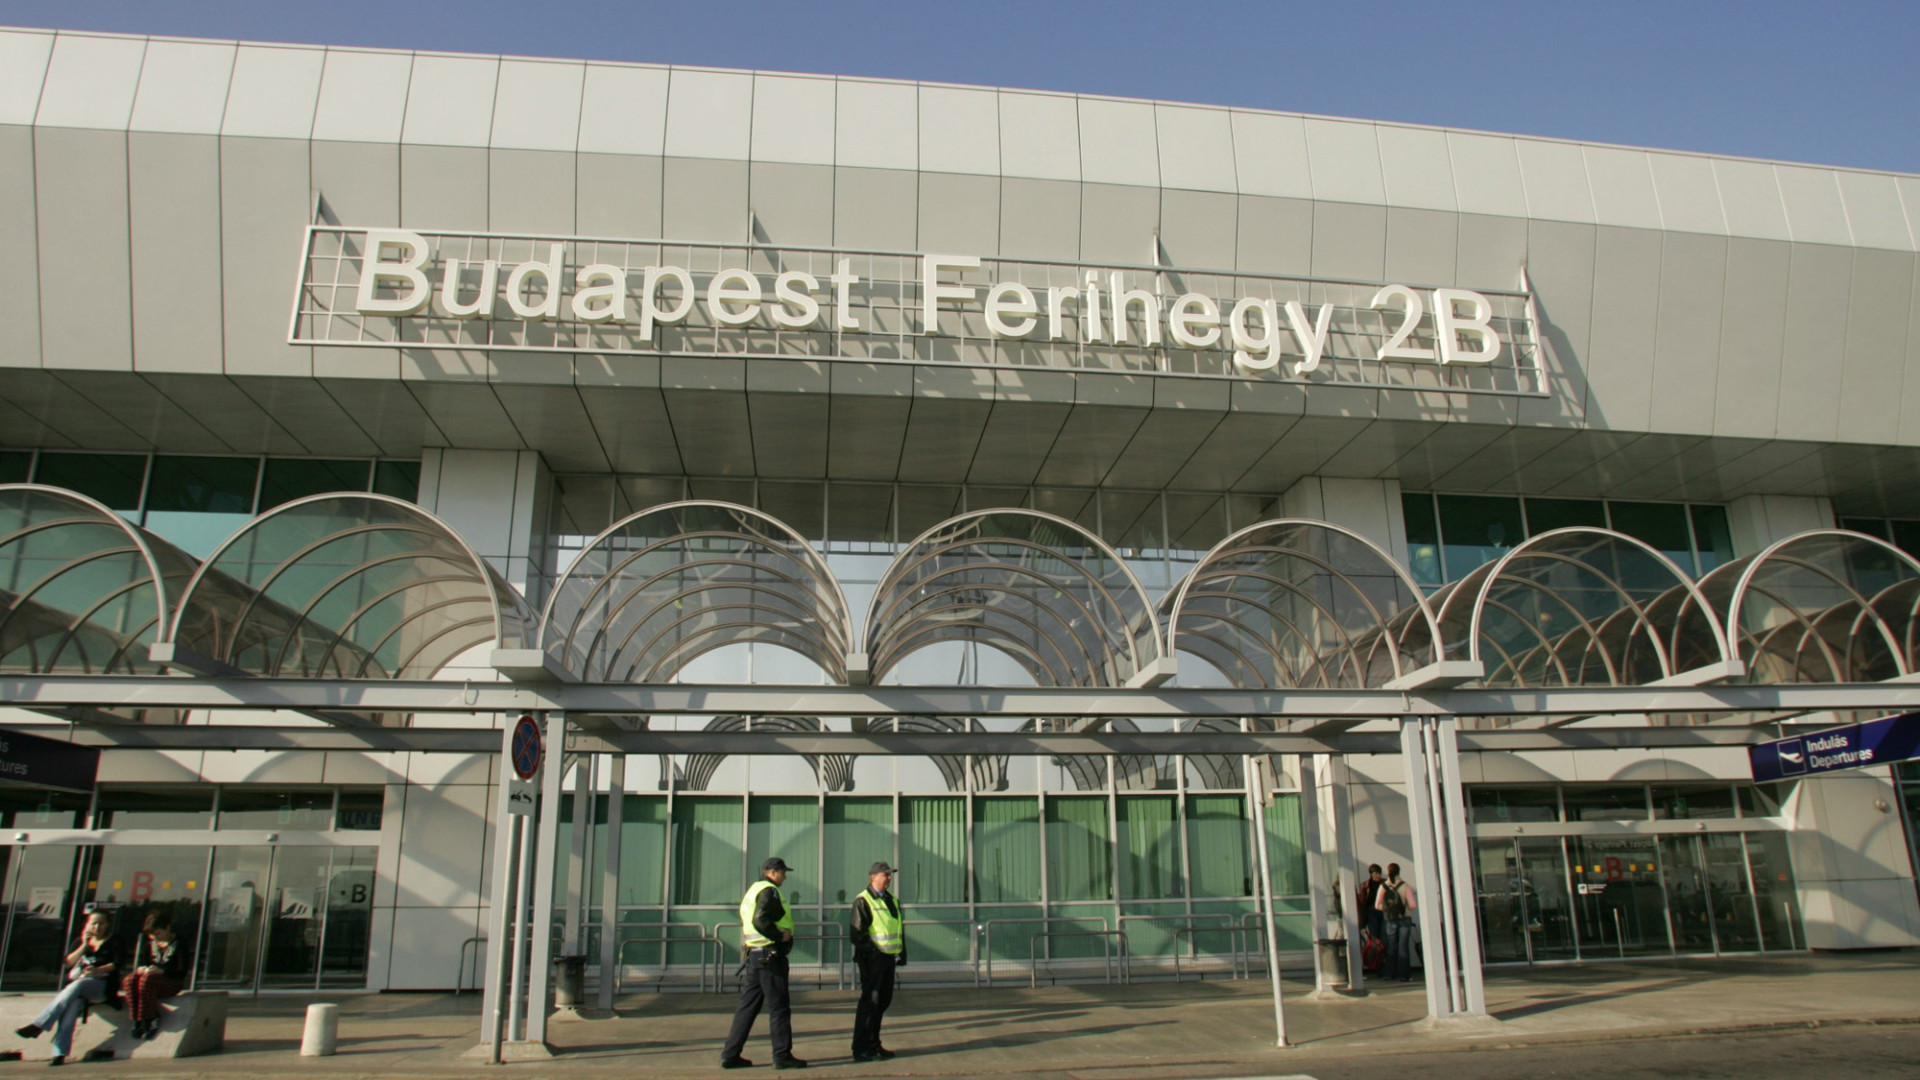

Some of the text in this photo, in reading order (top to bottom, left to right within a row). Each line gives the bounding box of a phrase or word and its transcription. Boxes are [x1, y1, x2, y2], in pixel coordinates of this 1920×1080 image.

[357, 231, 1501, 375] Budapest Ferihegy 2B
[1806, 735, 1848, 752] Indulás
[0, 760, 28, 775] ures
[1810, 749, 1873, 768] Departures
[1606, 857, 1623, 882] B
[131, 872, 154, 900] B
[351, 884, 367, 903] B
